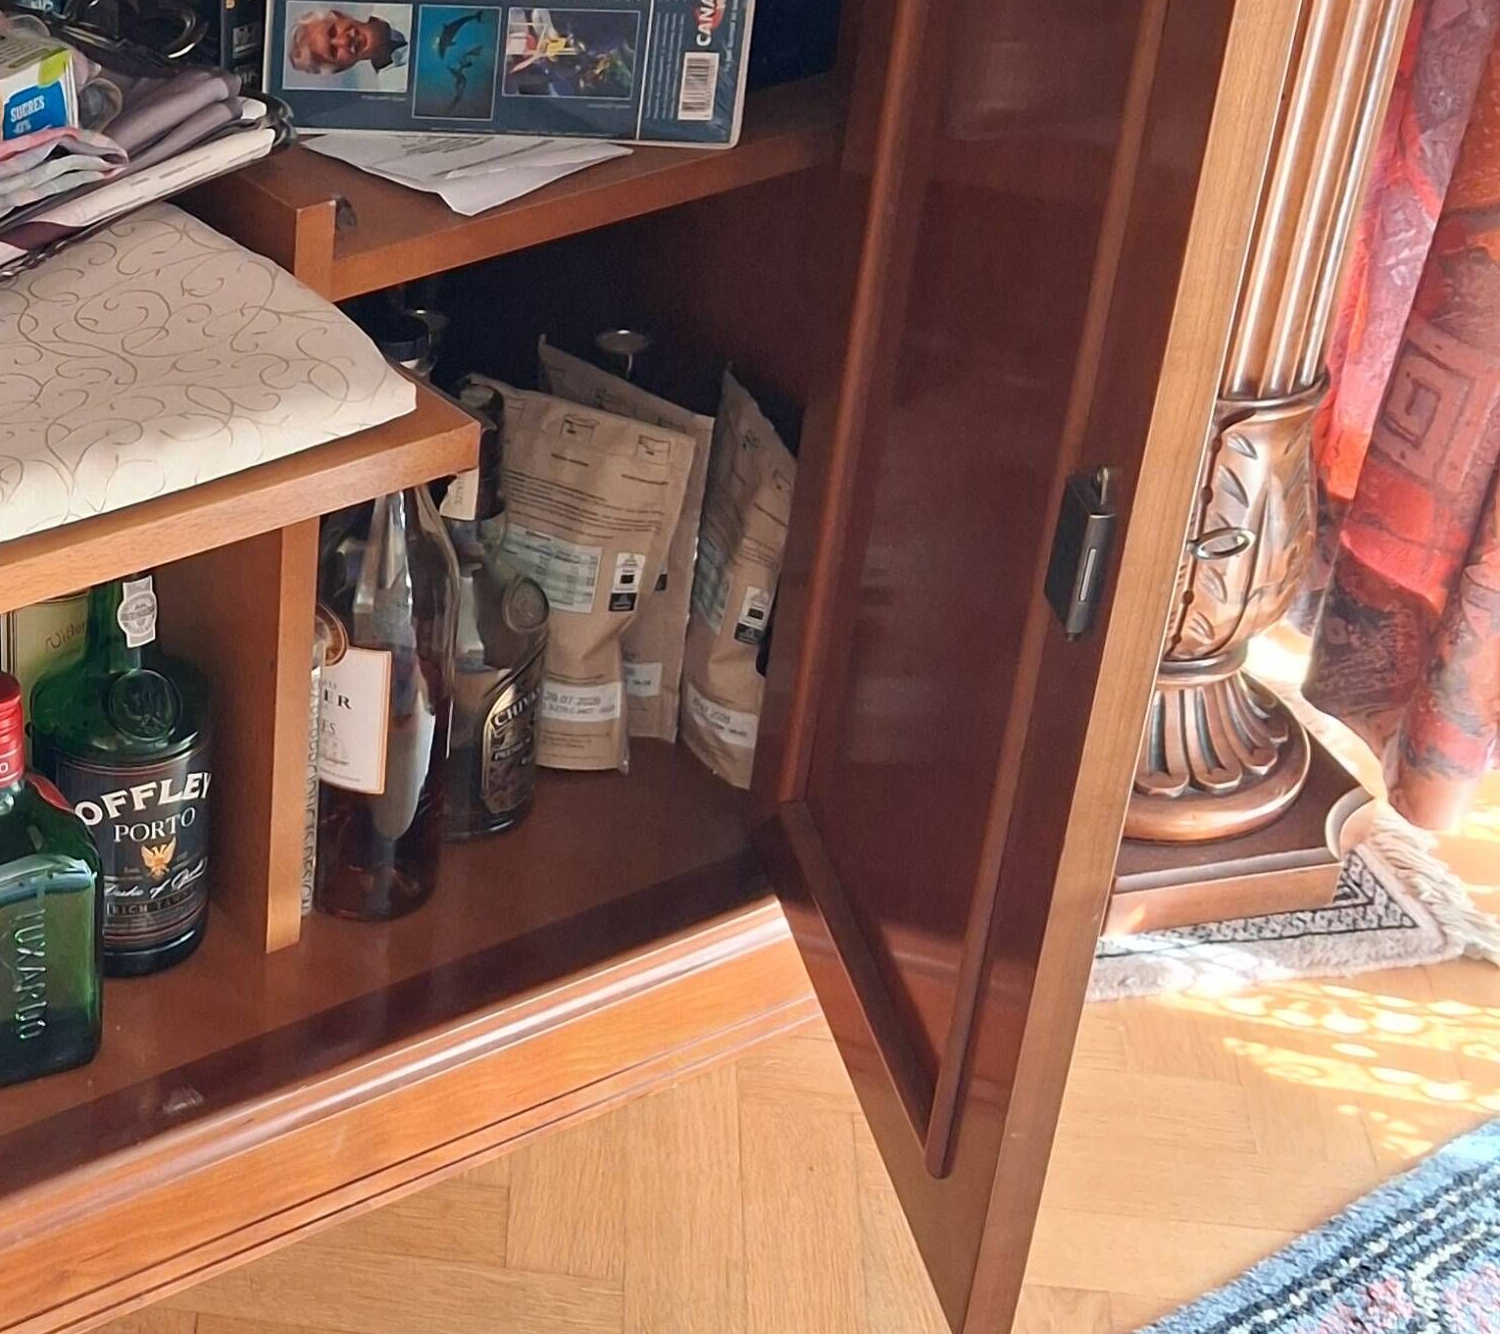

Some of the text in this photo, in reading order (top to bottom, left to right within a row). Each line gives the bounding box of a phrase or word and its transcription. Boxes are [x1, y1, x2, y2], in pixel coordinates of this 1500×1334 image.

[10, 95, 45, 123] SUCRES
[74, 772, 213, 827] OFFLEY
[113, 806, 197, 843] PORTO
